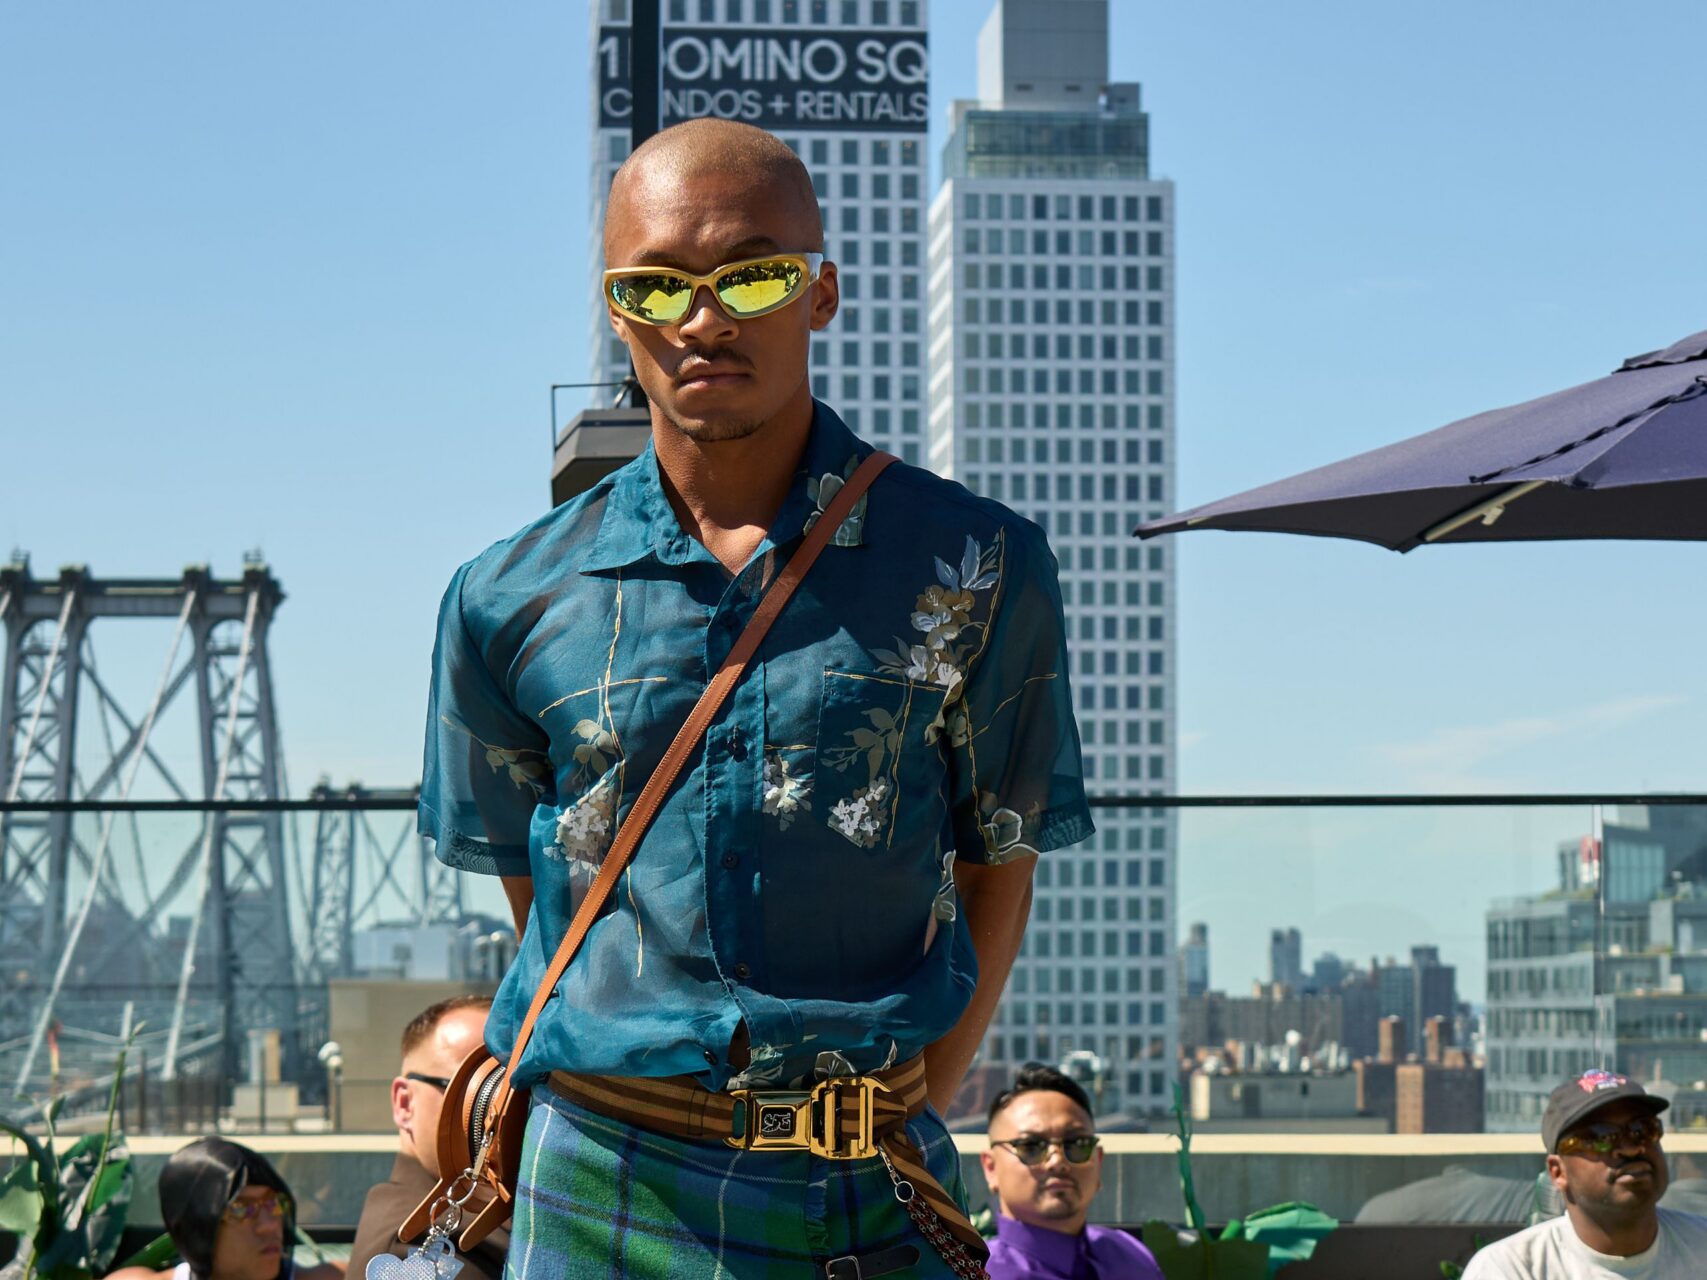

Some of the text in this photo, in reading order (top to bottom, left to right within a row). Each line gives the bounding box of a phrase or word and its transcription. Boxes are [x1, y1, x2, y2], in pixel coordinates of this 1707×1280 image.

[598, 36, 928, 84] 1 OMINO SQ
[602, 87, 763, 119] CNDOS
[795, 91, 928, 122] RENTALS
